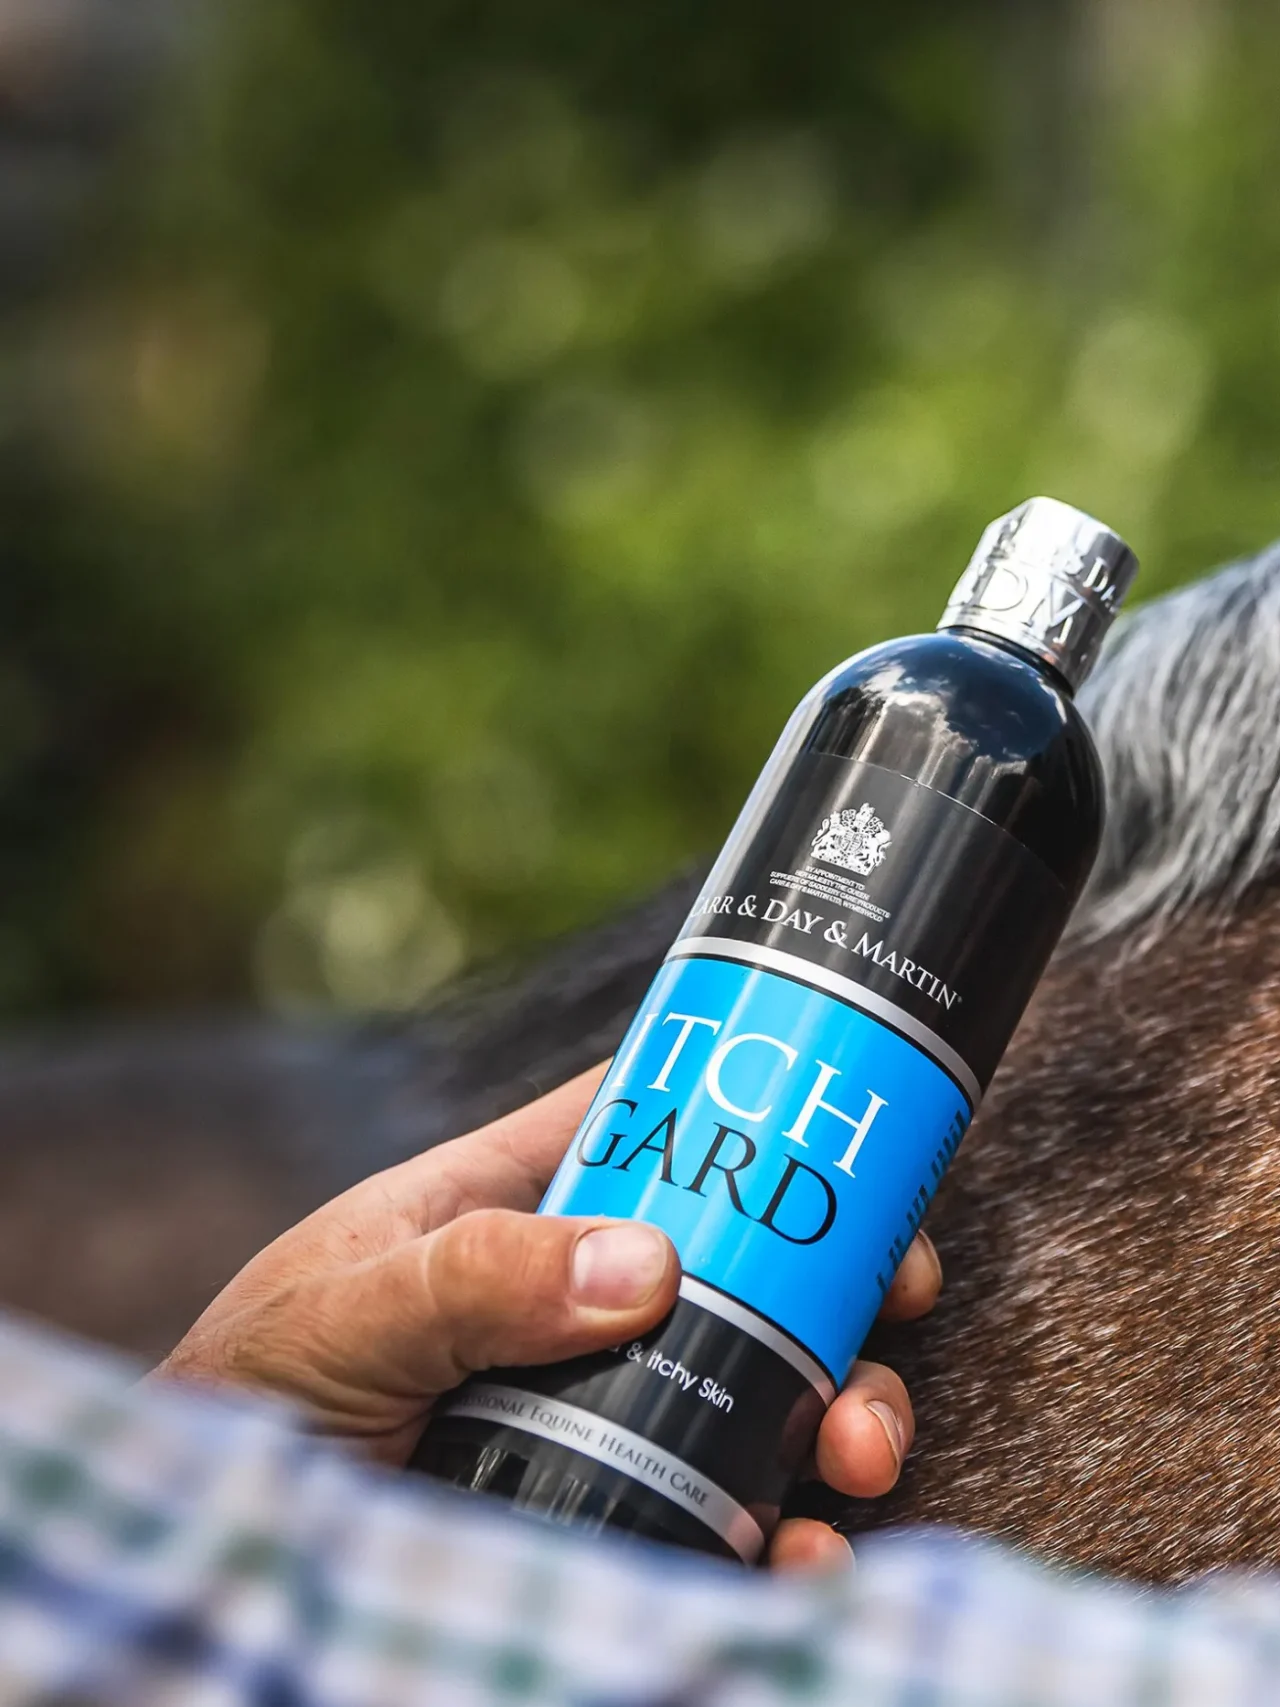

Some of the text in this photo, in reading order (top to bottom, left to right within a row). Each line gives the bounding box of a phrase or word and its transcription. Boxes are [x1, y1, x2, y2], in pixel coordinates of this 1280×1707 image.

[737, 894, 757, 918] &
[760, 898, 824, 934] DAY
[823, 920, 848, 949] &
[851, 932, 957, 1010] MARTIN
[611, 1012, 889, 1178] ITCH
[576, 1098, 838, 1246] GARD
[627, 1342, 734, 1413] & itchy Skin
[529, 1405, 594, 1441] EQUINE
[599, 1433, 667, 1480] HEALTH
[669, 1472, 708, 1507] CARE
